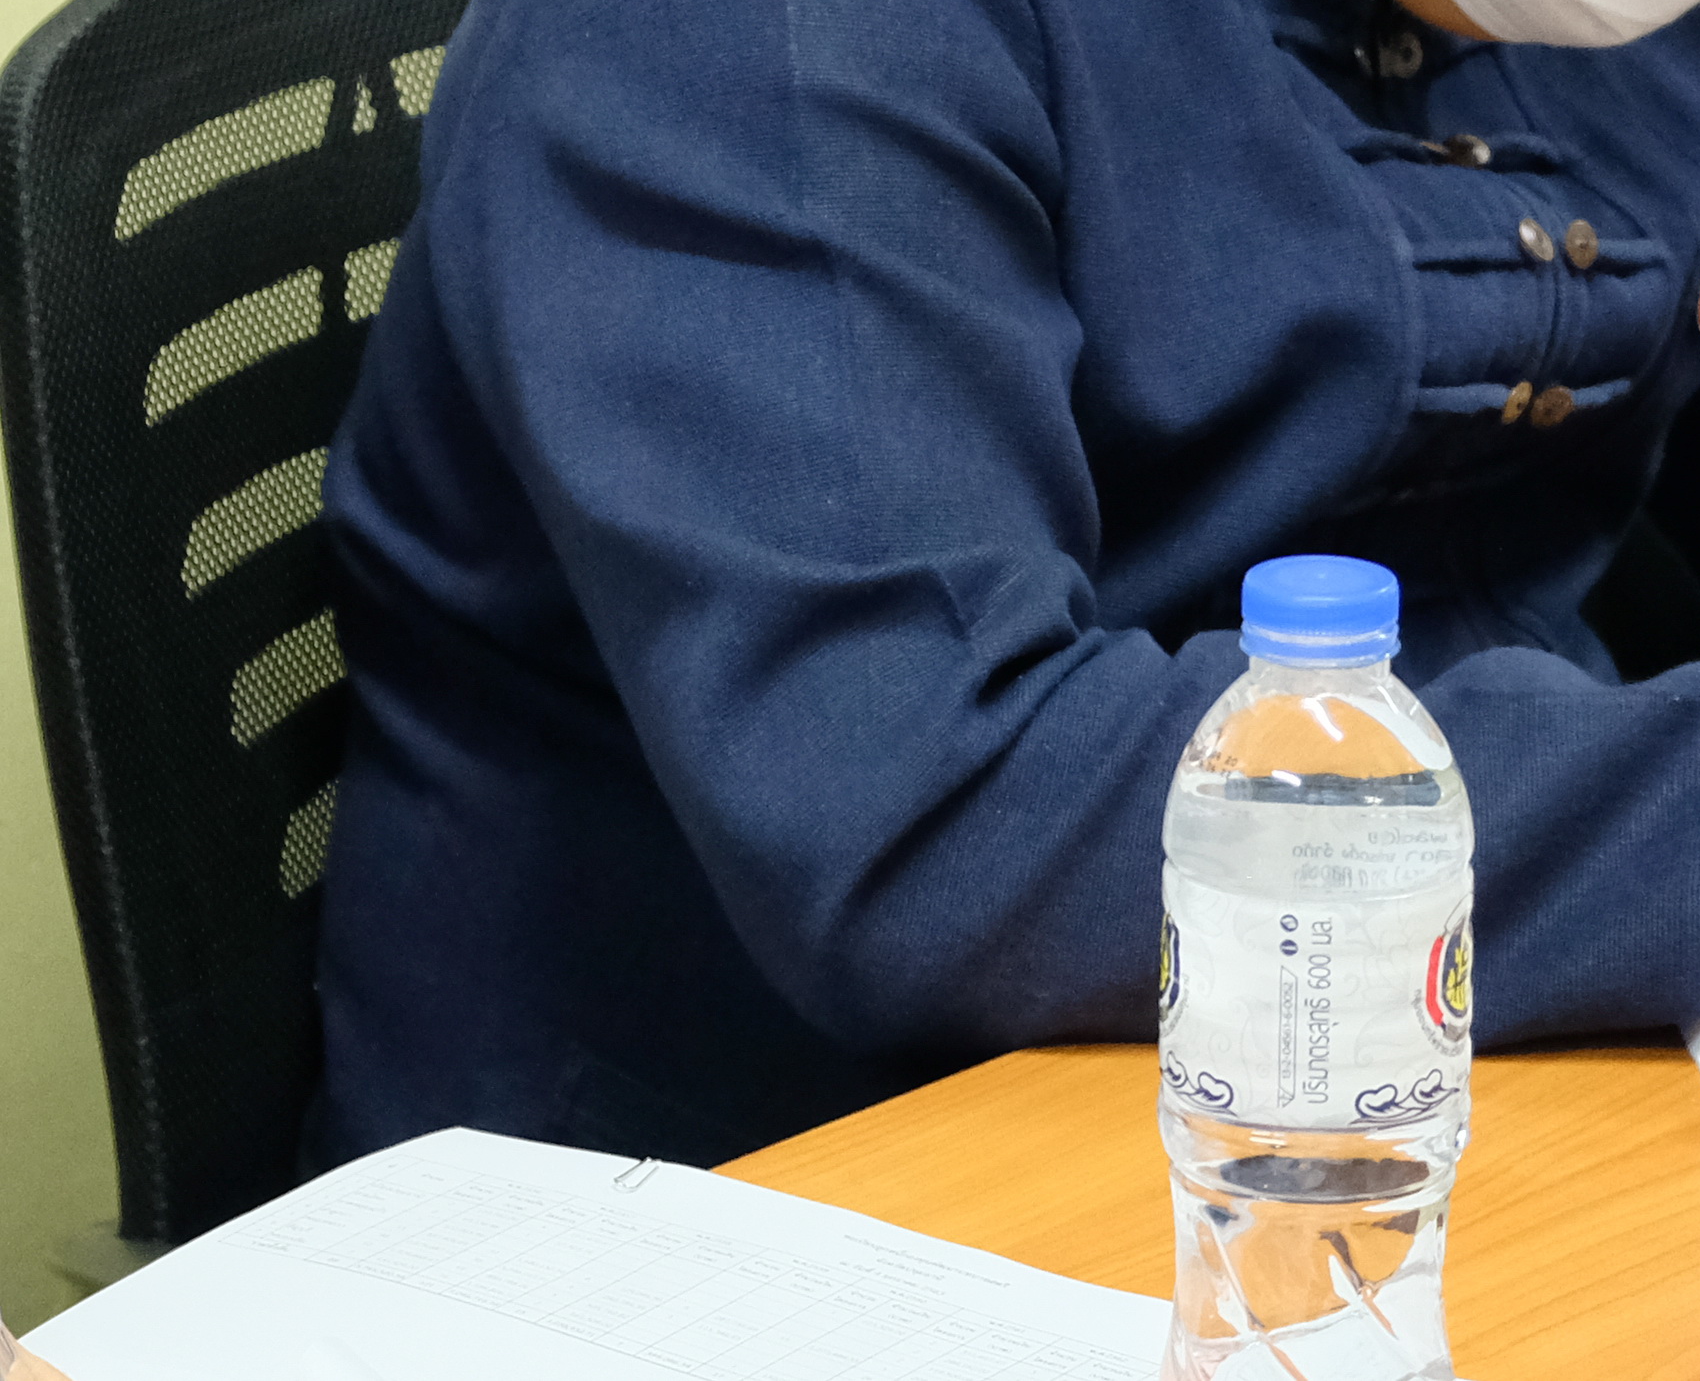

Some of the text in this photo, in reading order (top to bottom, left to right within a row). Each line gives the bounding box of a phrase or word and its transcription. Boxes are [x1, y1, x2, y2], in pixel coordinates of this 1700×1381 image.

[1307, 953, 1332, 990] 600
[1303, 998, 1339, 1104] ปริมาตรสุทธิ
